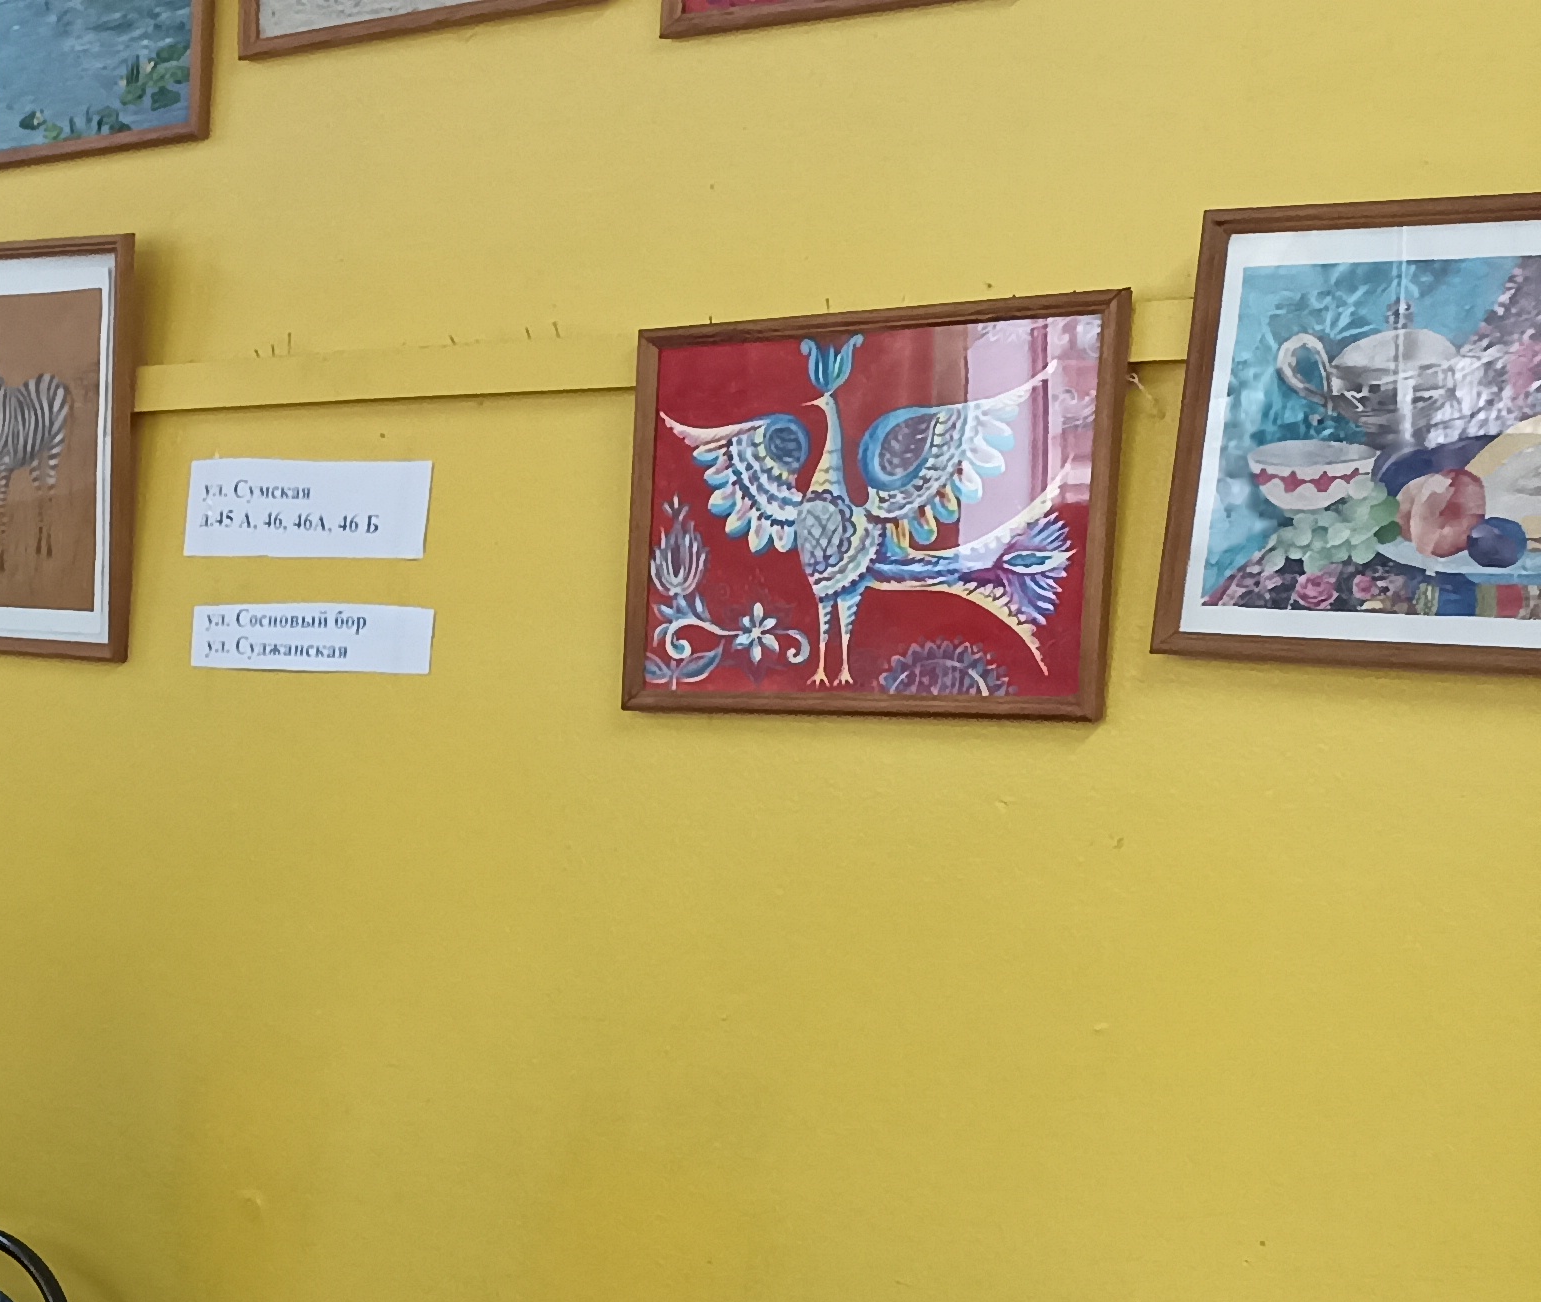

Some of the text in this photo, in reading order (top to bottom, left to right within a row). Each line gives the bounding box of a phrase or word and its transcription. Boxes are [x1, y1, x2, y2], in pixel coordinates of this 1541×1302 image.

[202, 479, 311, 503] ул. Сумская
[263, 511, 288, 531] 46,
[337, 513, 360, 533] 46
[365, 514, 381, 534] Б
[204, 608, 367, 635] ул. Сосновый бор
[204, 636, 348, 660] ул. Суджанская
